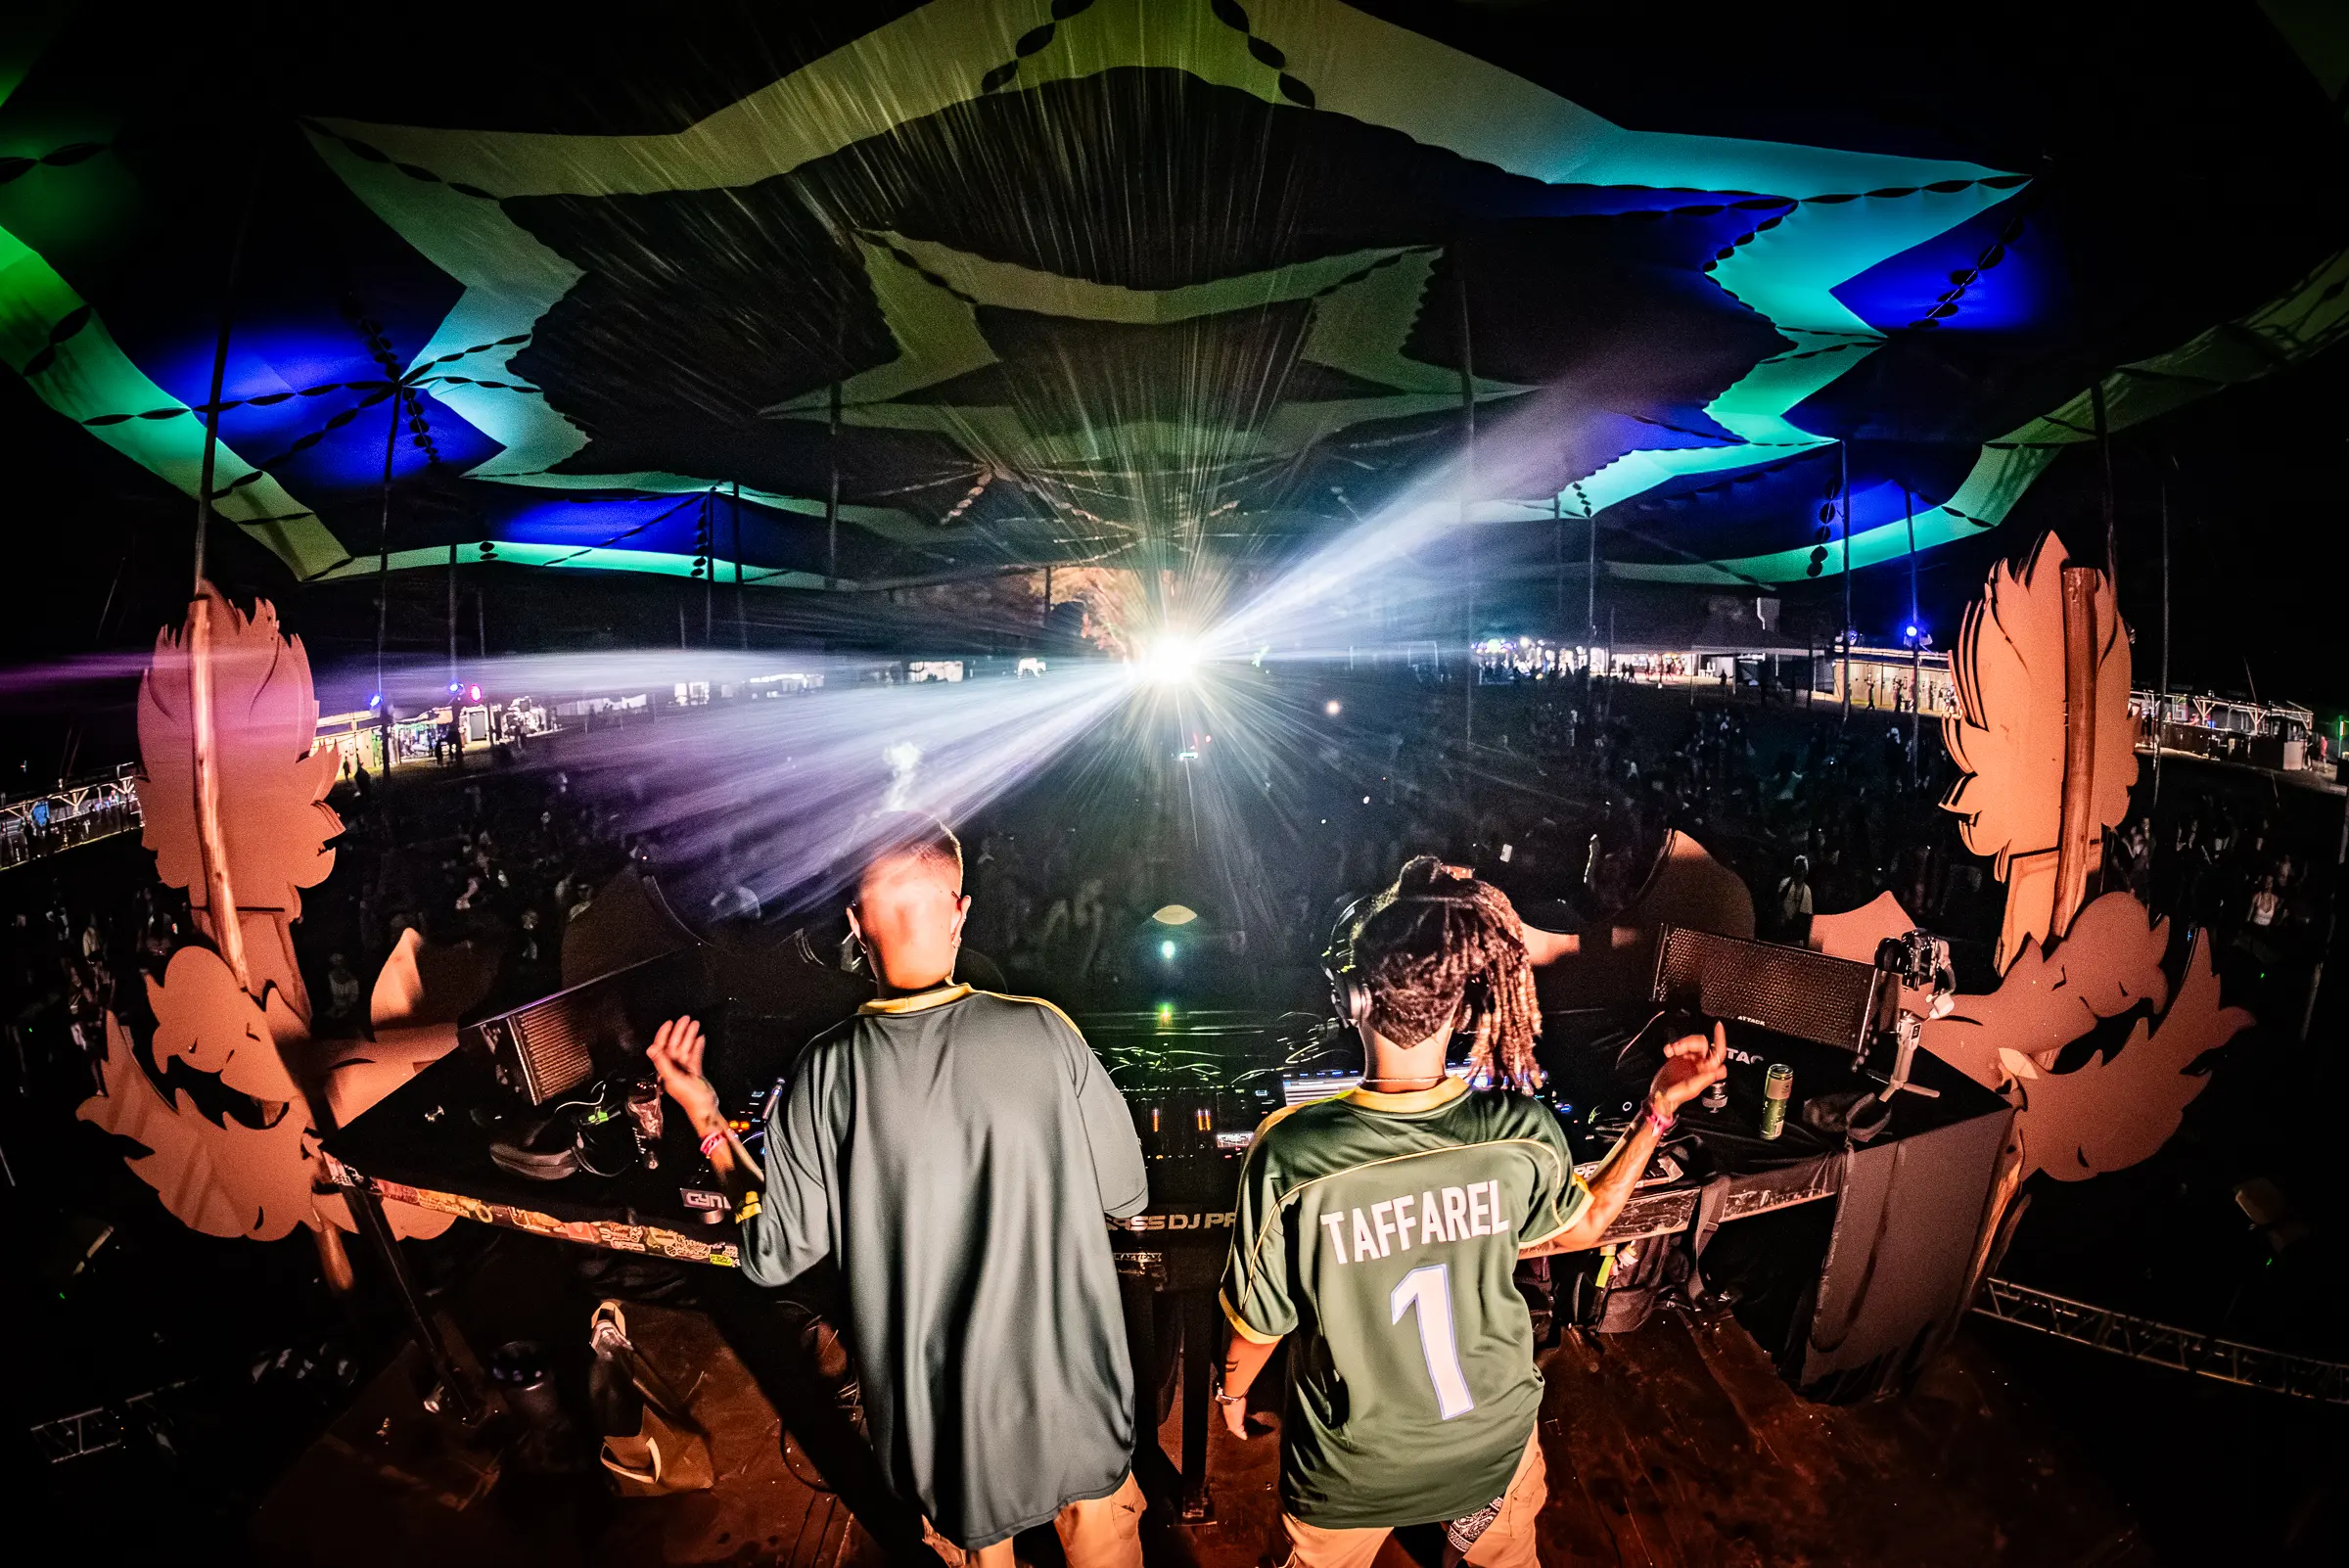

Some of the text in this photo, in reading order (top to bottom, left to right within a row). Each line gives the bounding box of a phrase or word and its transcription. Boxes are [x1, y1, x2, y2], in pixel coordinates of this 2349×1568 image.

[1737, 1015, 1766, 1026] ATTACK
[1168, 1214, 1201, 1230] DJ
[1320, 1179, 1509, 1265] TAFFAREL
[1390, 1264, 1474, 1420] 1
